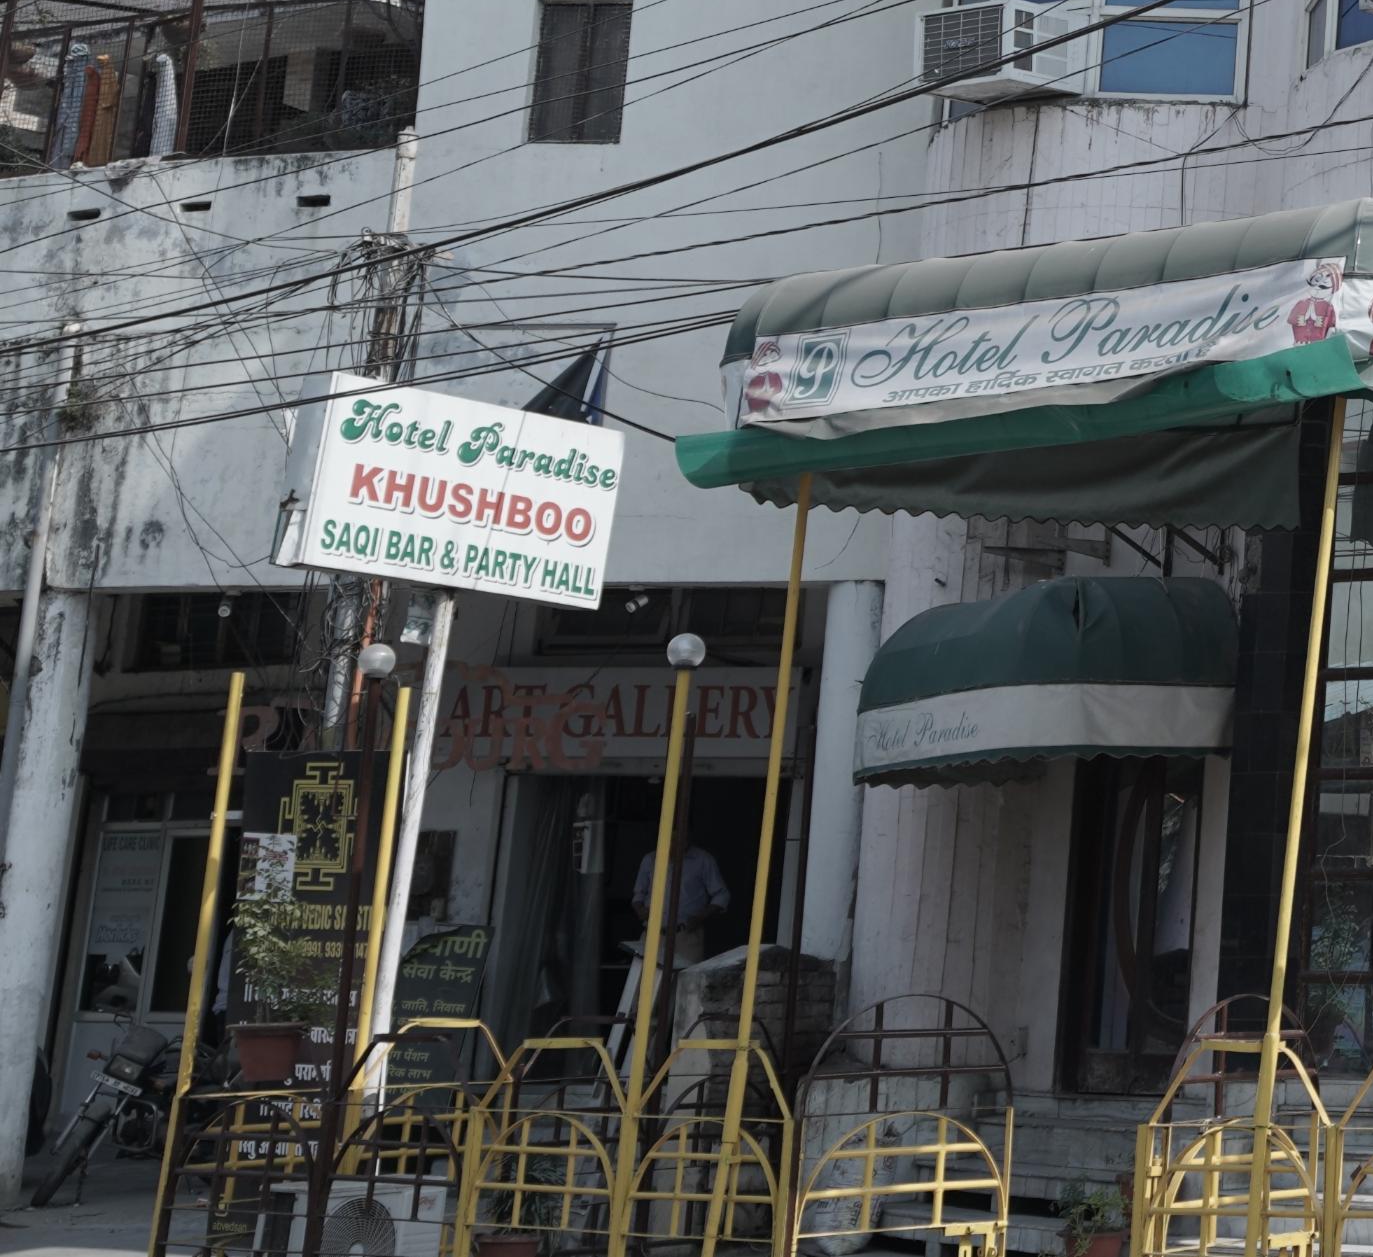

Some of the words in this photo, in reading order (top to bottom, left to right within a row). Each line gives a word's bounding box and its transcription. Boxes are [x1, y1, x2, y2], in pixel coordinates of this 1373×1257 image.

[851, 313, 1040, 388] Hotel
[1041, 285, 1280, 366] Paradise
[882, 383, 959, 404] आपका
[1045, 360, 1125, 384] स्वागत
[339, 399, 453, 452] Hotel
[458, 421, 617, 488] Paradise
[348, 463, 593, 542] KHUSHBOO
[320, 519, 379, 558] SAQI
[385, 530, 434, 566] BAR
[440, 541, 455, 569] &
[462, 544, 538, 584] PARTY
[541, 558, 595, 596] HALL
[441, 684, 547, 738] ART
[914, 712, 978, 747] Paradise
